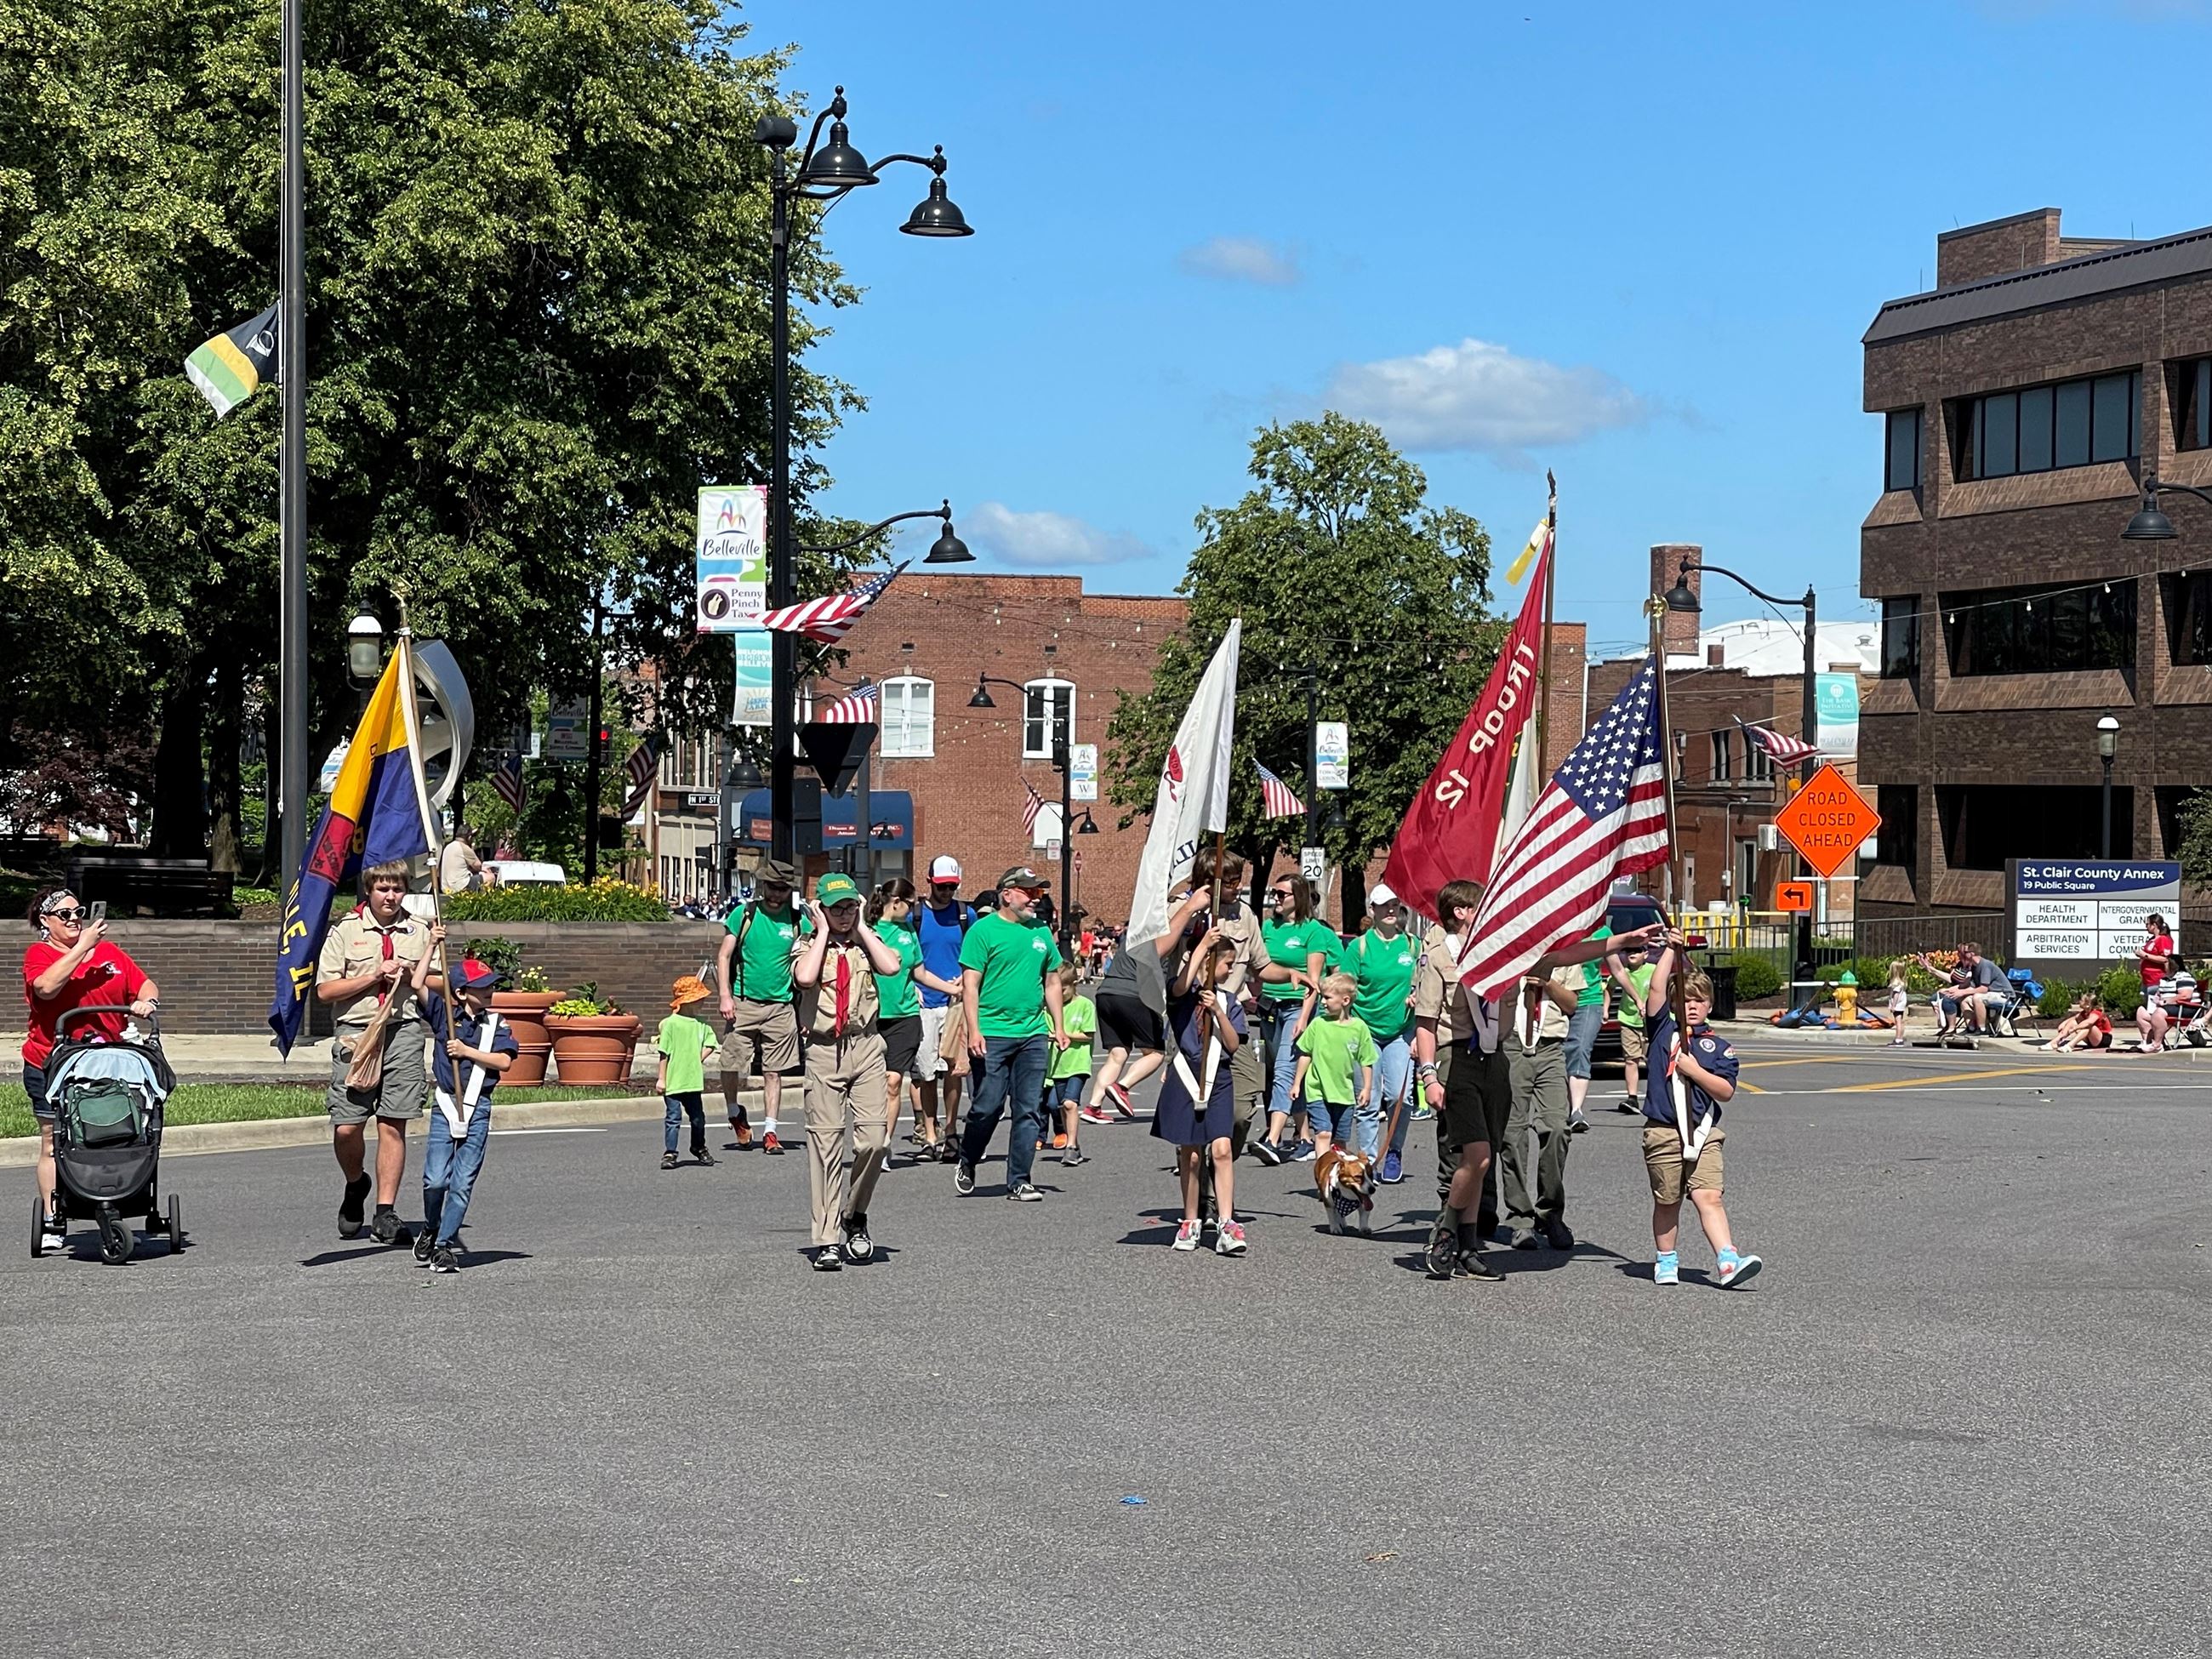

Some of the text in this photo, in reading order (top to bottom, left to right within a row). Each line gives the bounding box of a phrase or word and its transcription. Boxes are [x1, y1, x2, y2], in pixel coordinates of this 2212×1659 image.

[703, 539, 760, 556] Belleville
[731, 588, 762, 599] Penny
[731, 599, 760, 607] Pinch
[731, 609, 750, 619] Tax
[1807, 792, 1848, 805] ROAD
[1799, 812, 1856, 826] CLOSED
[1803, 834, 1853, 847] AHEAD
[1303, 865, 1322, 877] 20
[2023, 866, 2164, 881] St. Clair County Annex
[2023, 881, 2095, 891] 19 Public Square
[2039, 905, 2075, 914] HEALTH
[2026, 915, 2088, 924] DEPARTMENT
[2119, 915, 2147, 924] GRAN
[2027, 934, 2088, 944] ARBITRATION
[2113, 935, 2150, 944] VETERA
[2034, 944, 2080, 954] SERVICES
